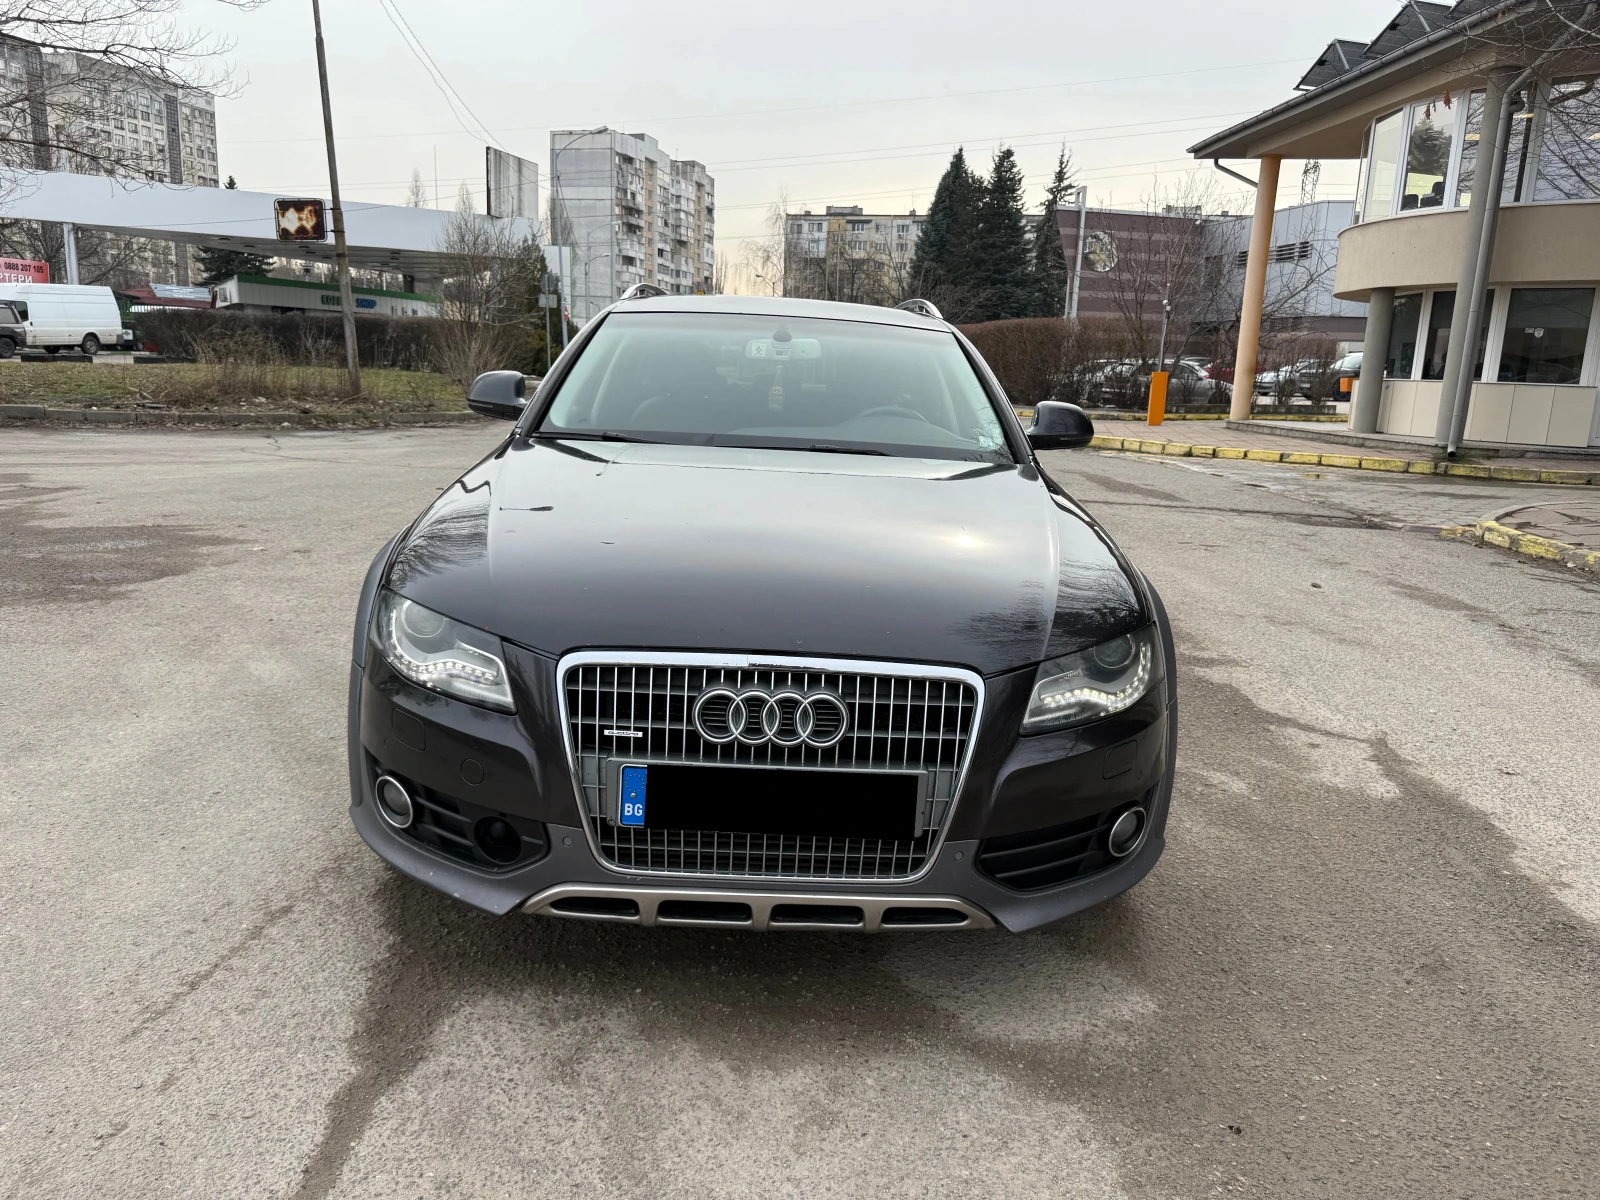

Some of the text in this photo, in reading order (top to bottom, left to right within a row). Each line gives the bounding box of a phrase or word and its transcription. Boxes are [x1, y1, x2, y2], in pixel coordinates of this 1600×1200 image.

[20, 264, 31, 272] 207
[33, 265, 44, 273] 105
[355, 298, 377, 309] SHOP
[624, 803, 643, 816] BG
